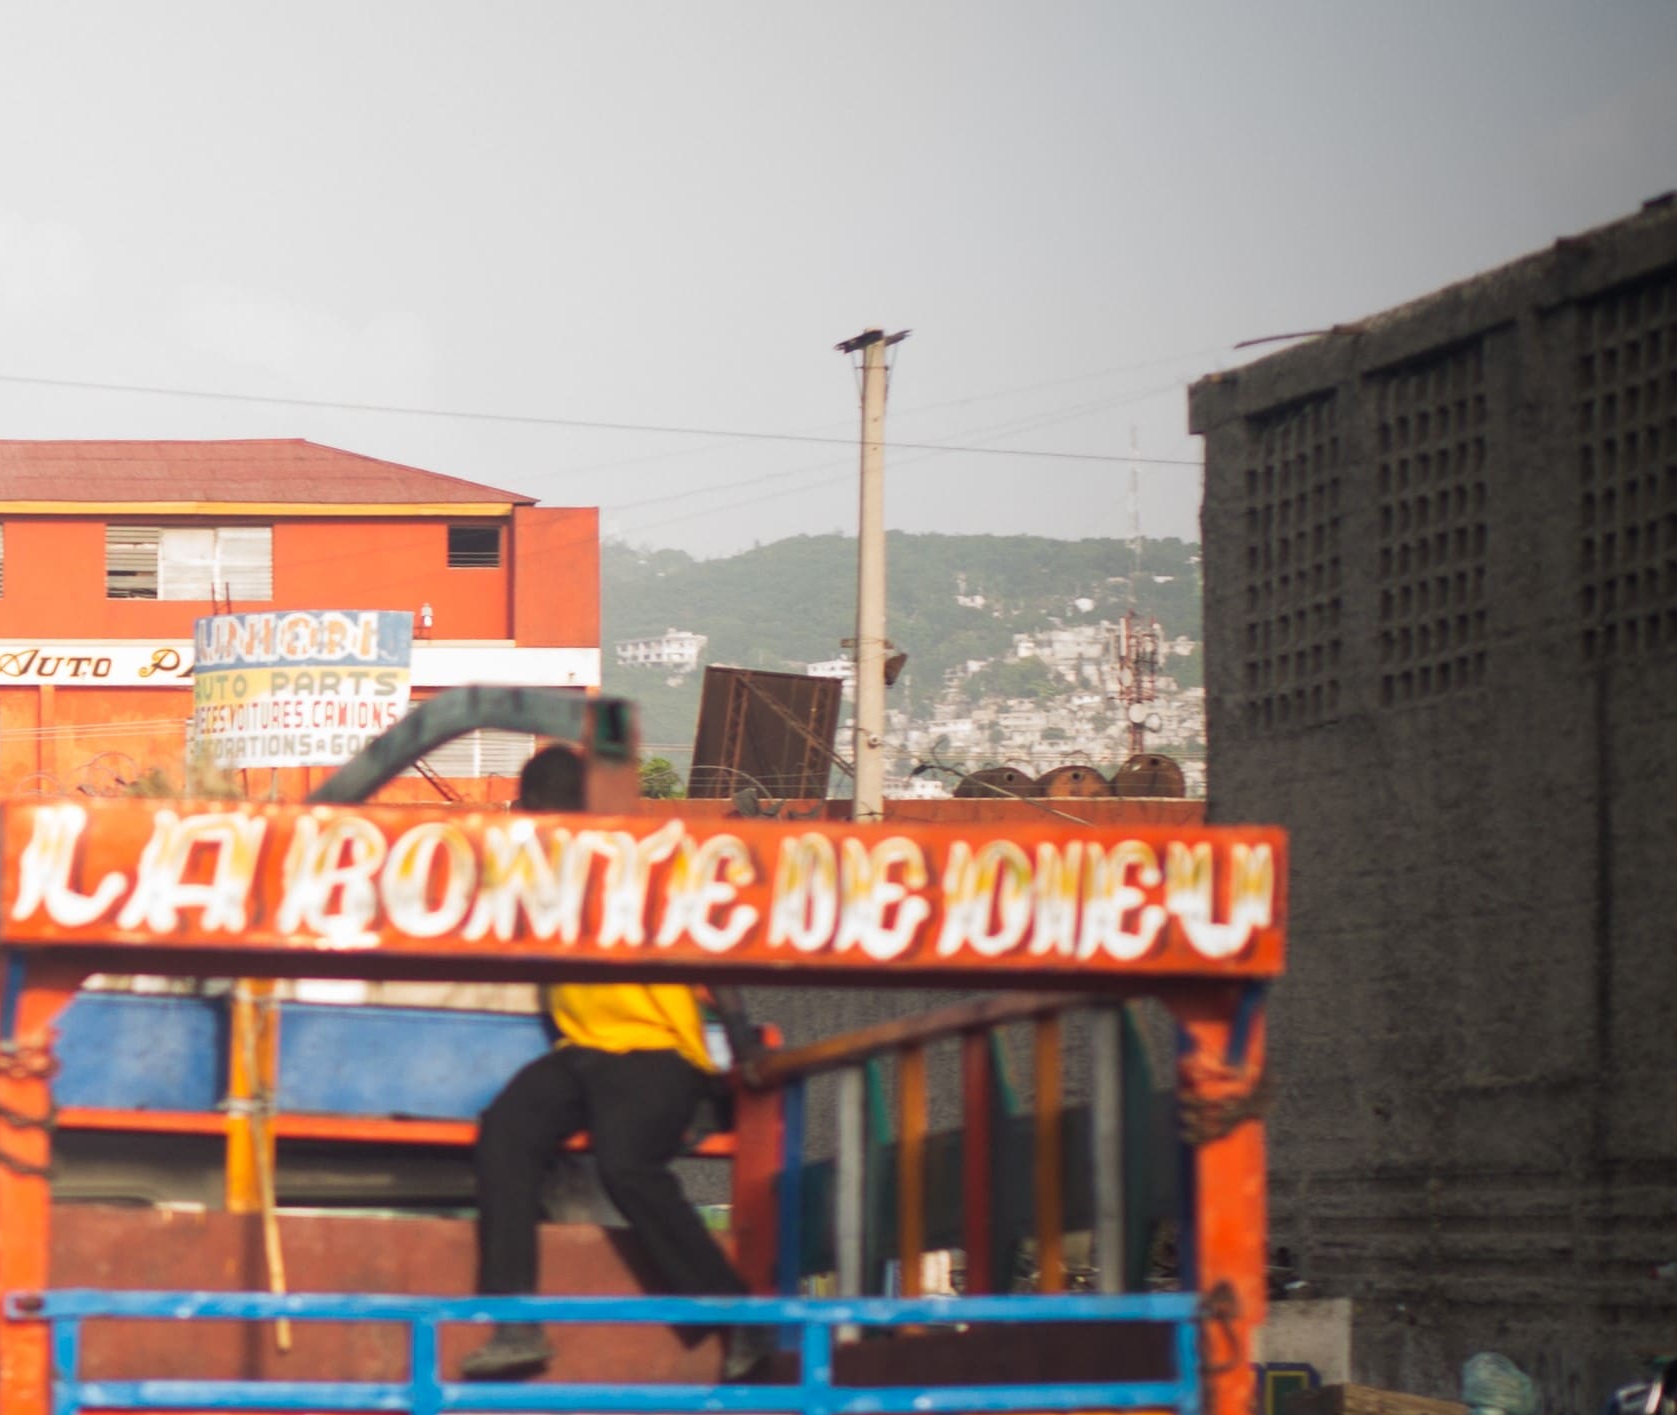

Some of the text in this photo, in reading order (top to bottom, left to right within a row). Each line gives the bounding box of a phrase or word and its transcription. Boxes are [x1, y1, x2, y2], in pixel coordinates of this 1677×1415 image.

[196, 671, 399, 700] AUTO PARTS
[312, 701, 398, 730] CAMIONS
[12, 803, 1274, 965] LA BONTE DE DIEU
